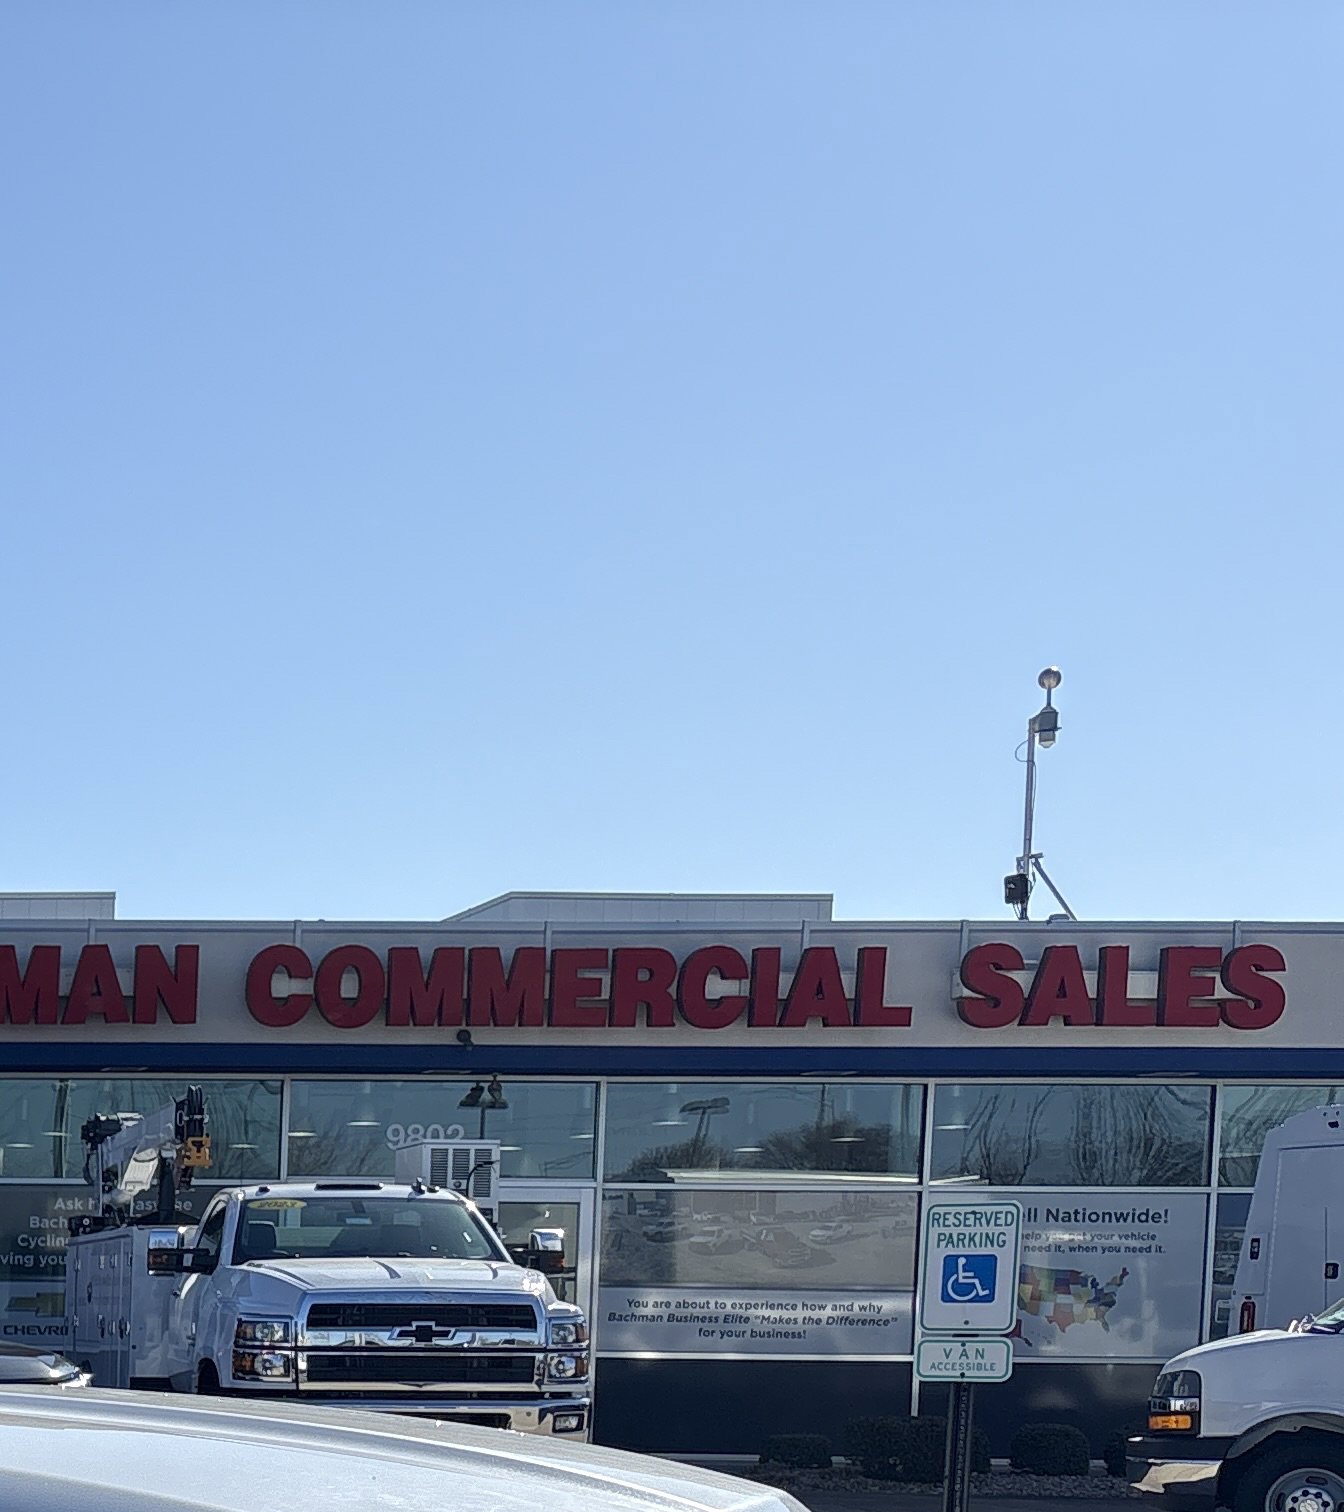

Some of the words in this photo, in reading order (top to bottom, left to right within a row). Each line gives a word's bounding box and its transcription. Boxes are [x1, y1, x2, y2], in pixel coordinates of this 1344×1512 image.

[246, 943, 912, 1029] COMMERCIAL
[956, 943, 1287, 1031] SALES
[386, 1123, 465, 1151] 9802
[54, 1197, 83, 1211] Ask
[29, 1215, 68, 1229] Bach
[931, 1210, 1015, 1228] RESERVED
[1045, 1207, 1169, 1224] Nationwide!
[936, 1231, 1007, 1249] PARKING
[1090, 1232, 1115, 1242] your
[1118, 1231, 1157, 1242] vehicle
[1024, 1243, 1052, 1253] need
[1068, 1243, 1099, 1254] when
[1101, 1245, 1121, 1255] you
[1124, 1244, 1152, 1254] need
[627, 1298, 649, 1309] You
[652, 1301, 671, 1310] are
[674, 1299, 711, 1310] about
[714, 1300, 727, 1310] to
[730, 1300, 798, 1313] experience
[801, 1301, 827, 1312] how
[830, 1302, 854, 1313] and
[858, 1302, 884, 1315] why
[607, 1312, 663, 1323] Bachman
[666, 1312, 720, 1324] Business
[723, 1313, 751, 1324] Elite
[802, 1315, 823, 1326] the
[698, 1327, 716, 1338] for
[719, 1329, 747, 1340] your
[750, 1328, 807, 1340] business!
[942, 1347, 986, 1361] VAN
[929, 1361, 997, 1372] ACCESSIBLE
